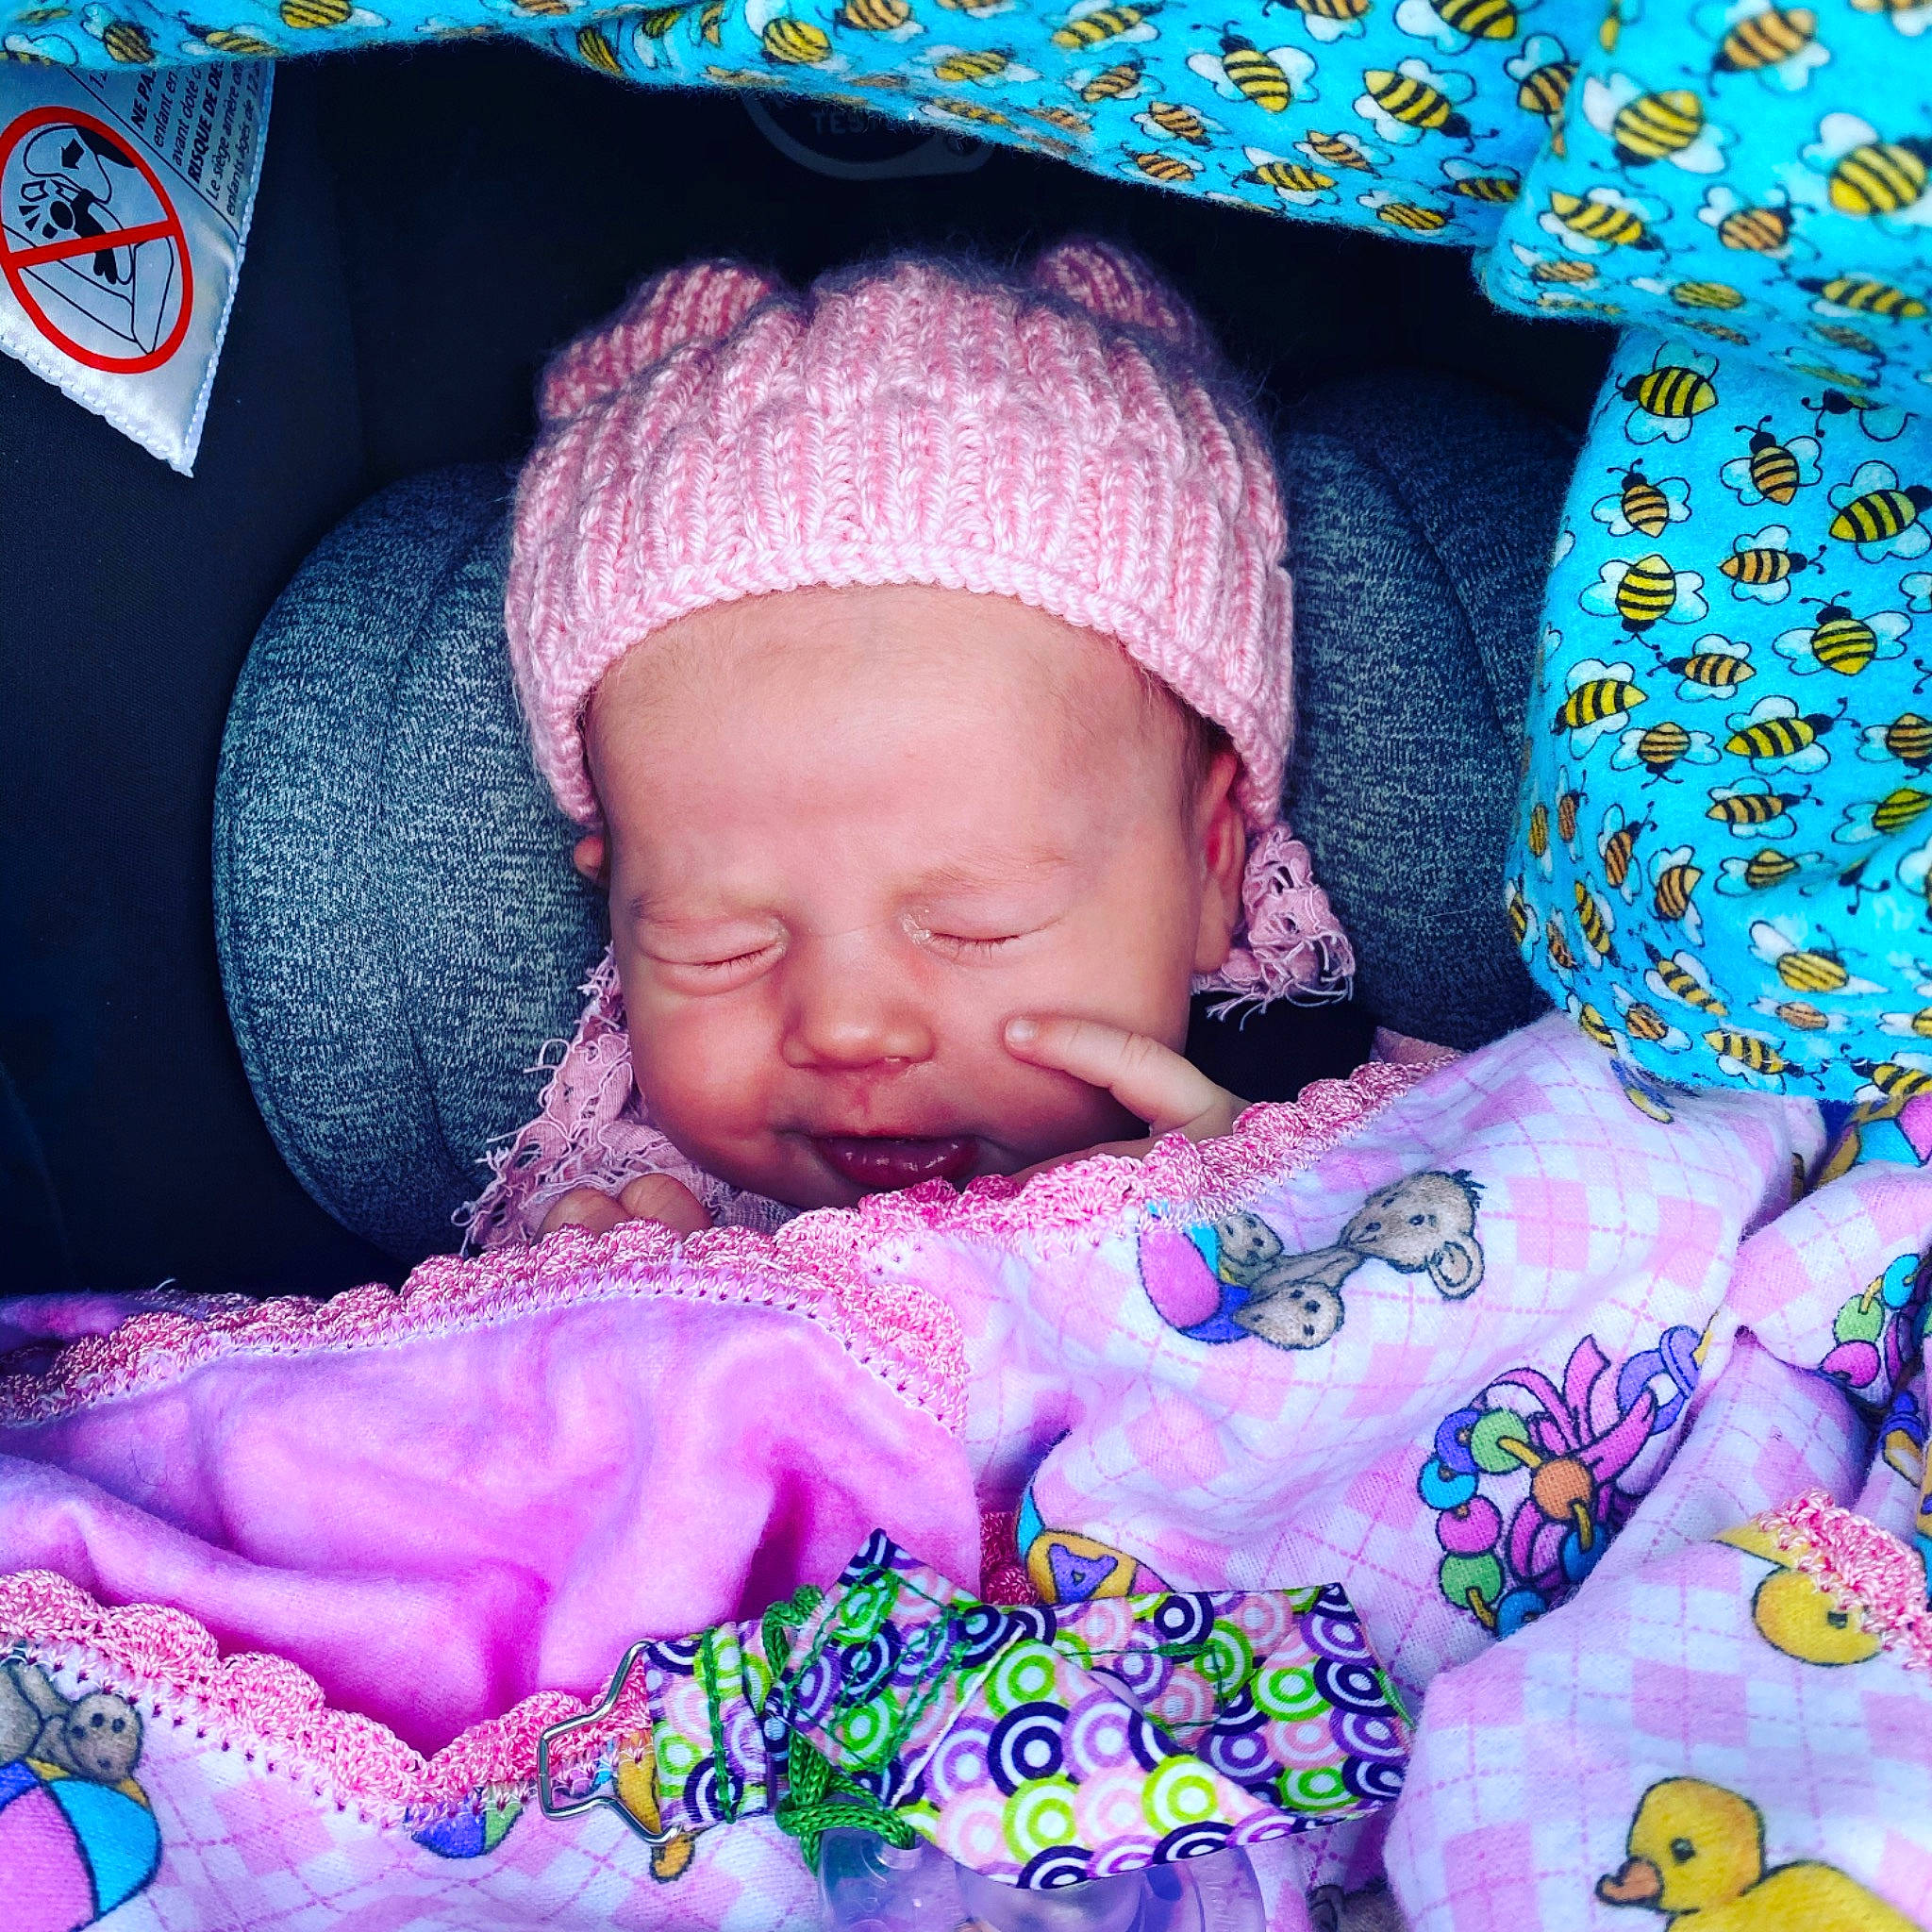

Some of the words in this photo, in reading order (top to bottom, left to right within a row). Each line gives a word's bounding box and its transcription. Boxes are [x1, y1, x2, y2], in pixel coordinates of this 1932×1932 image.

[137, 70, 158, 102] PA
[180, 76, 199, 119] doté
[130, 100, 148, 130] NE
[153, 92, 173, 148] enfant
[165, 71, 179, 94] en
[223, 86, 240, 137] arrière
[242, 99, 256, 122] de
[173, 119, 191, 168] avant
[187, 114, 213, 184] RISQUE
[202, 87, 218, 118] DE
[235, 123, 252, 159] âgés
[211, 136, 231, 180] siège
[205, 179, 222, 201] Le
[227, 158, 245, 218] enfants
